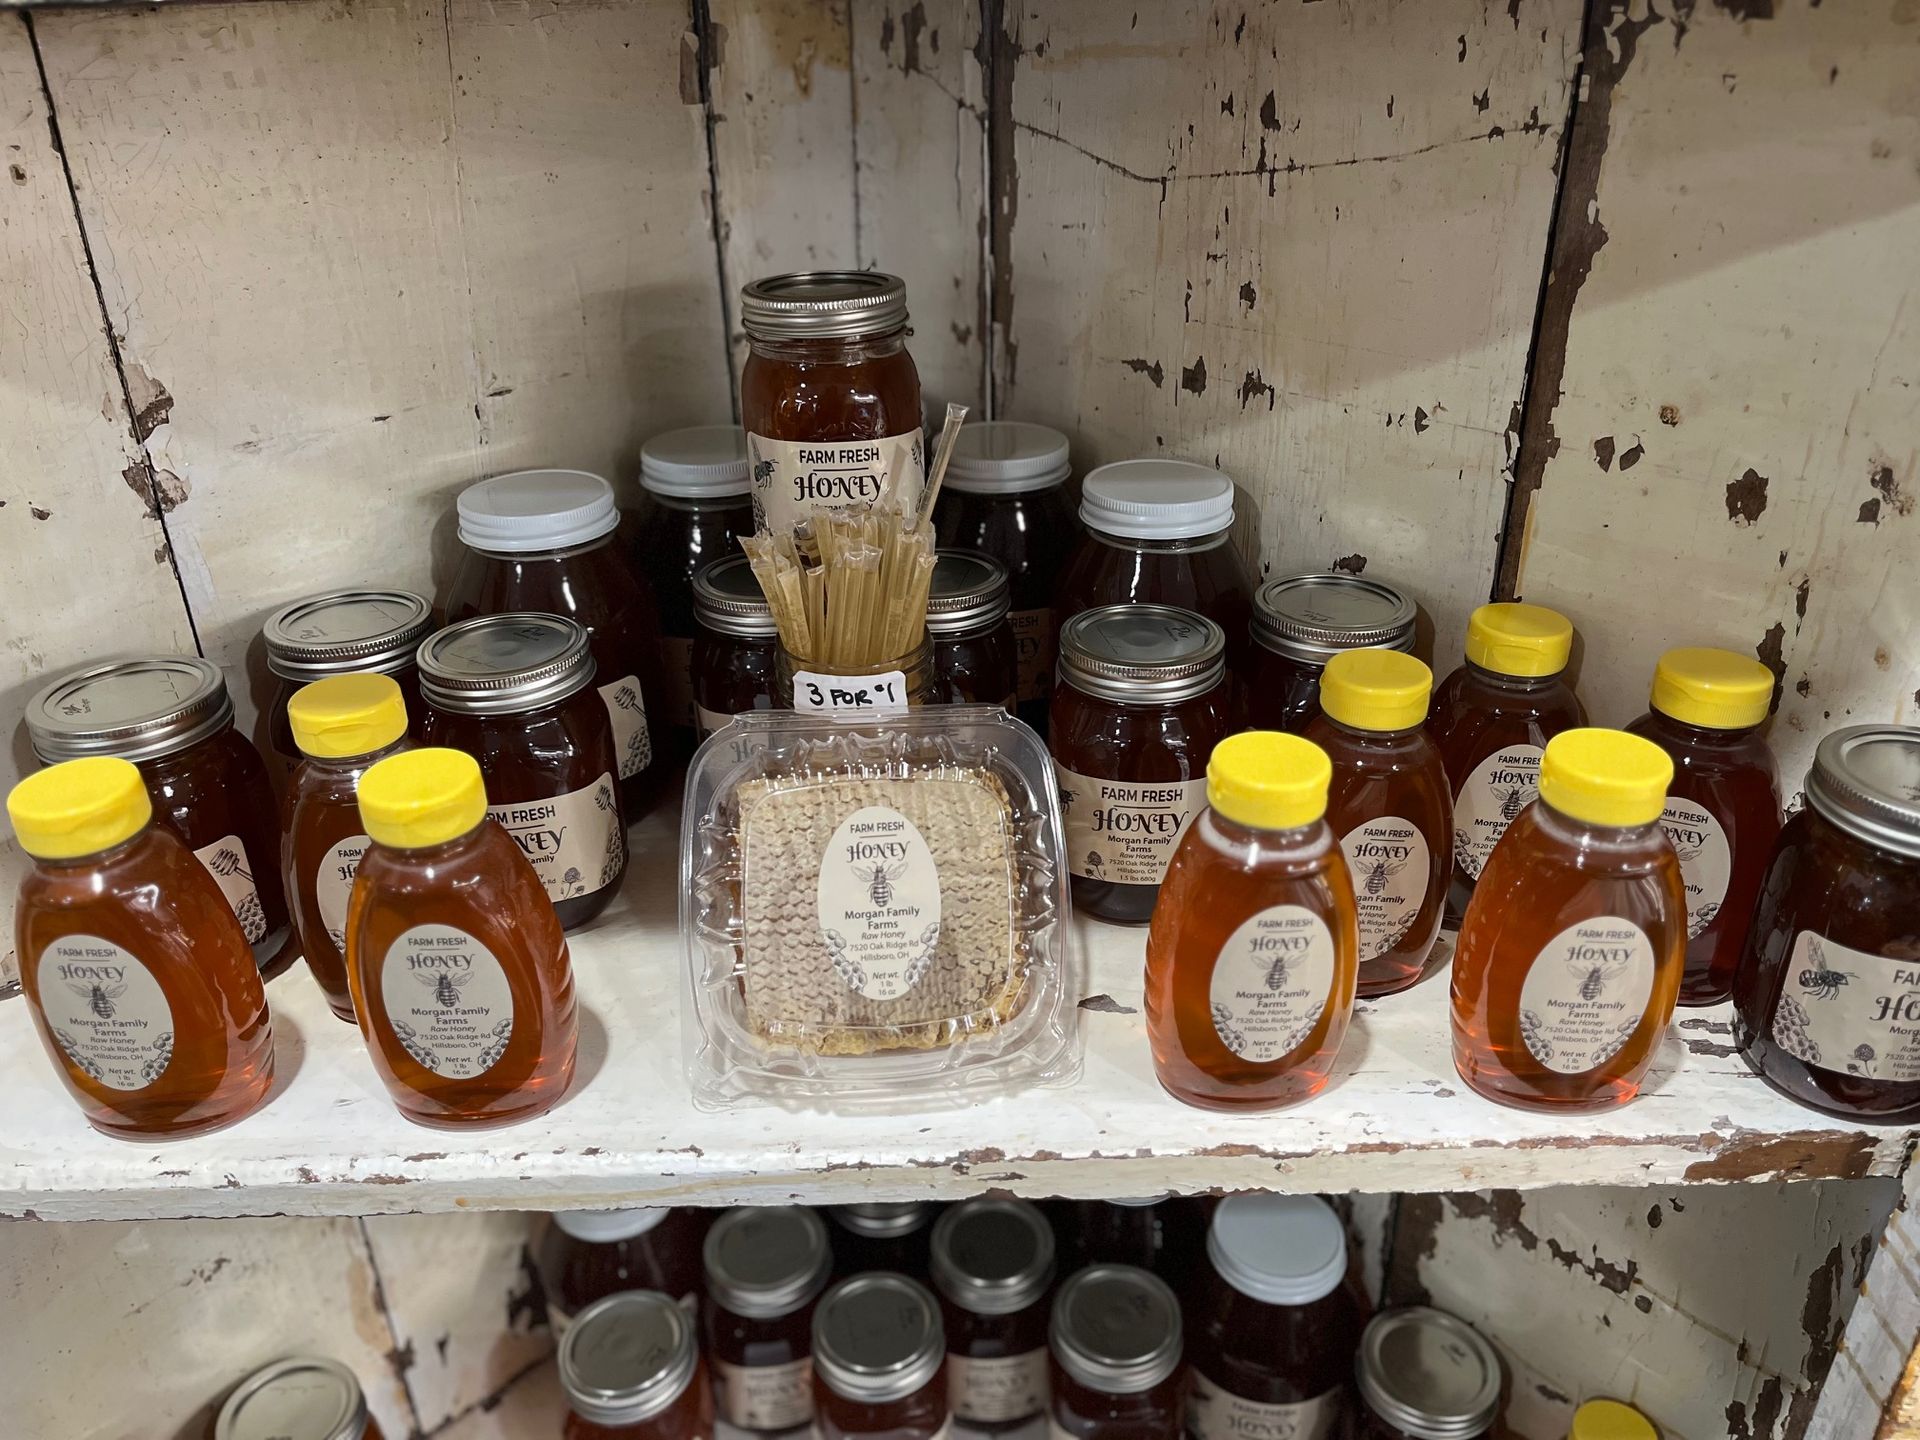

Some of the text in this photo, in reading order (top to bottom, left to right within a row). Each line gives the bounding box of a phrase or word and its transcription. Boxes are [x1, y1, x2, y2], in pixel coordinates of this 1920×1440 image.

[800, 448, 879, 463] FARM FRESH
[794, 472, 887, 502] HONEY
[806, 683, 824, 705] 3
[830, 689, 873, 706] FOR
[1498, 756, 1541, 765] FARM FRES
[1488, 769, 1540, 785] HONE
[1101, 787, 1183, 802] FARM FRESH
[512, 805, 556, 823] FRESH
[1662, 809, 1709, 824] RM FRESH
[850, 821, 904, 833] FARM FRESH
[1091, 808, 1189, 838] HONEY
[1474, 819, 1509, 827] Morgan
[1363, 828, 1414, 838] FARM FRESH
[1662, 826, 1711, 848] NEY
[513, 826, 567, 855] NEY
[1107, 835, 1141, 844] Morgan
[338, 849, 362, 858] FARM
[846, 841, 911, 863] HONEY
[1126, 845, 1152, 853] Farms
[1353, 843, 1415, 862] HONEY
[1356, 895, 1406, 904] gan Family
[845, 906, 920, 921] Morgan Family
[1364, 912, 1388, 920] Honey
[868, 921, 899, 930] Farms
[1257, 919, 1314, 928] FARM FRESH
[861, 930, 906, 940] Raw Honey
[1576, 929, 1636, 939] FARM FRESH
[408, 937, 467, 946] FARM FRESH
[850, 940, 919, 952] 7520 Oak Ridge Rd
[1248, 935, 1316, 952] HONEY
[57, 948, 117, 957] FARM FRESH
[861, 953, 896, 961] Hillsboro,
[1564, 945, 1636, 964] HONEY
[406, 952, 476, 970] HONEY
[57, 963, 127, 982] HONEY
[872, 972, 887, 980] Net
[1893, 969, 1920, 986] FA
[878, 988, 886, 996] 16
[1236, 990, 1311, 1000] Morgan Family
[1547, 1000, 1626, 1011] Morgan Family
[411, 1007, 490, 1017] Morgan Family
[1568, 1010, 1600, 1019] Farms
[69, 1017, 148, 1029] Morgan Family
[94, 1029, 127, 1037] Farms
[456, 1033, 479, 1041] Ridge
[1889, 1026, 1920, 1038] Morg
[109, 1037, 136, 1045] Honey
[116, 1045, 139, 1053] Ridge
[93, 1053, 129, 1061] Hillsboro,
